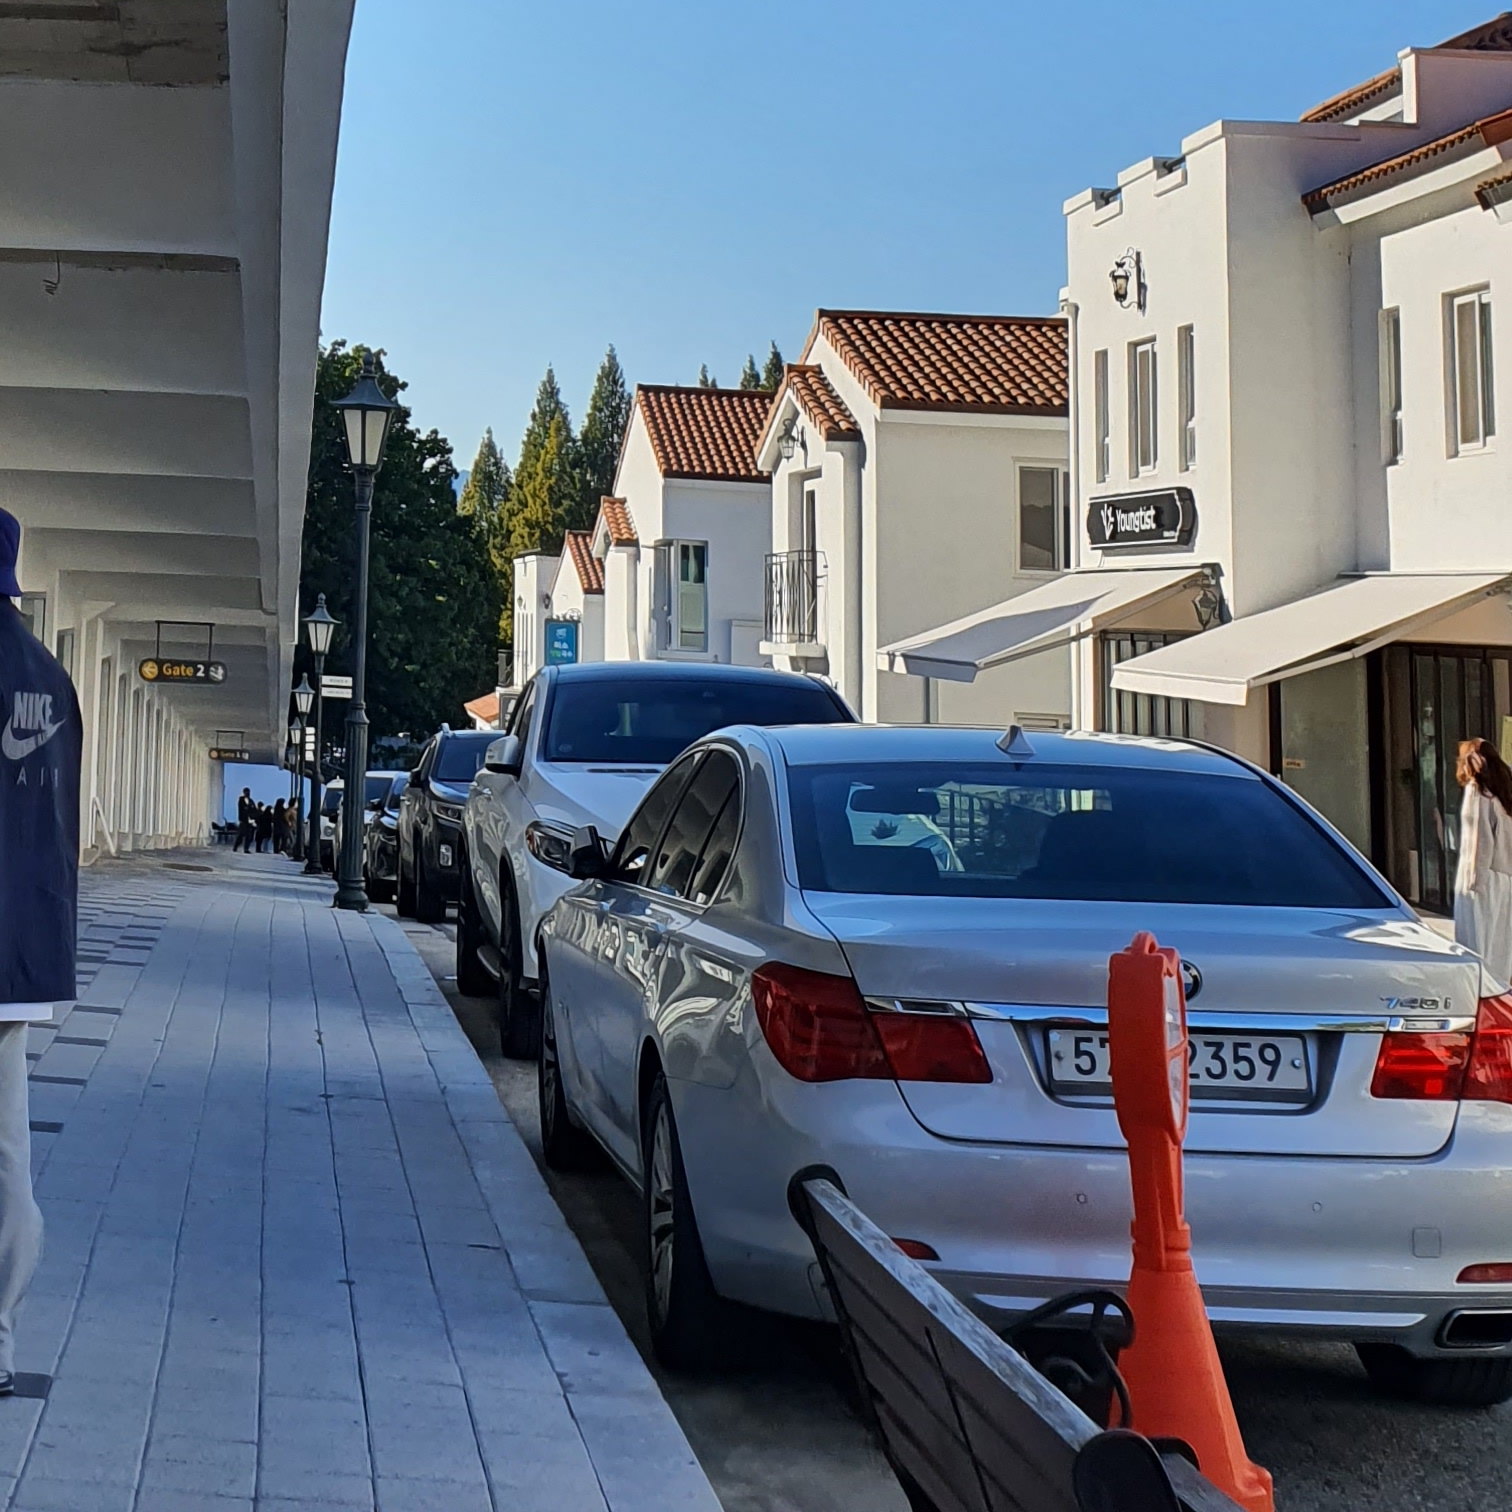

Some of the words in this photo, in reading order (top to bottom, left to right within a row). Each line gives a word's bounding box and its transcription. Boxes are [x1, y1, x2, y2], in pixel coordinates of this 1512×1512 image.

[1115, 504, 1157, 534] Youngtist
[162, 662, 194, 677] Gate
[196, 663, 206, 677] 2
[13, 691, 55, 730] NIKE
[16, 766, 59, 788] AI
